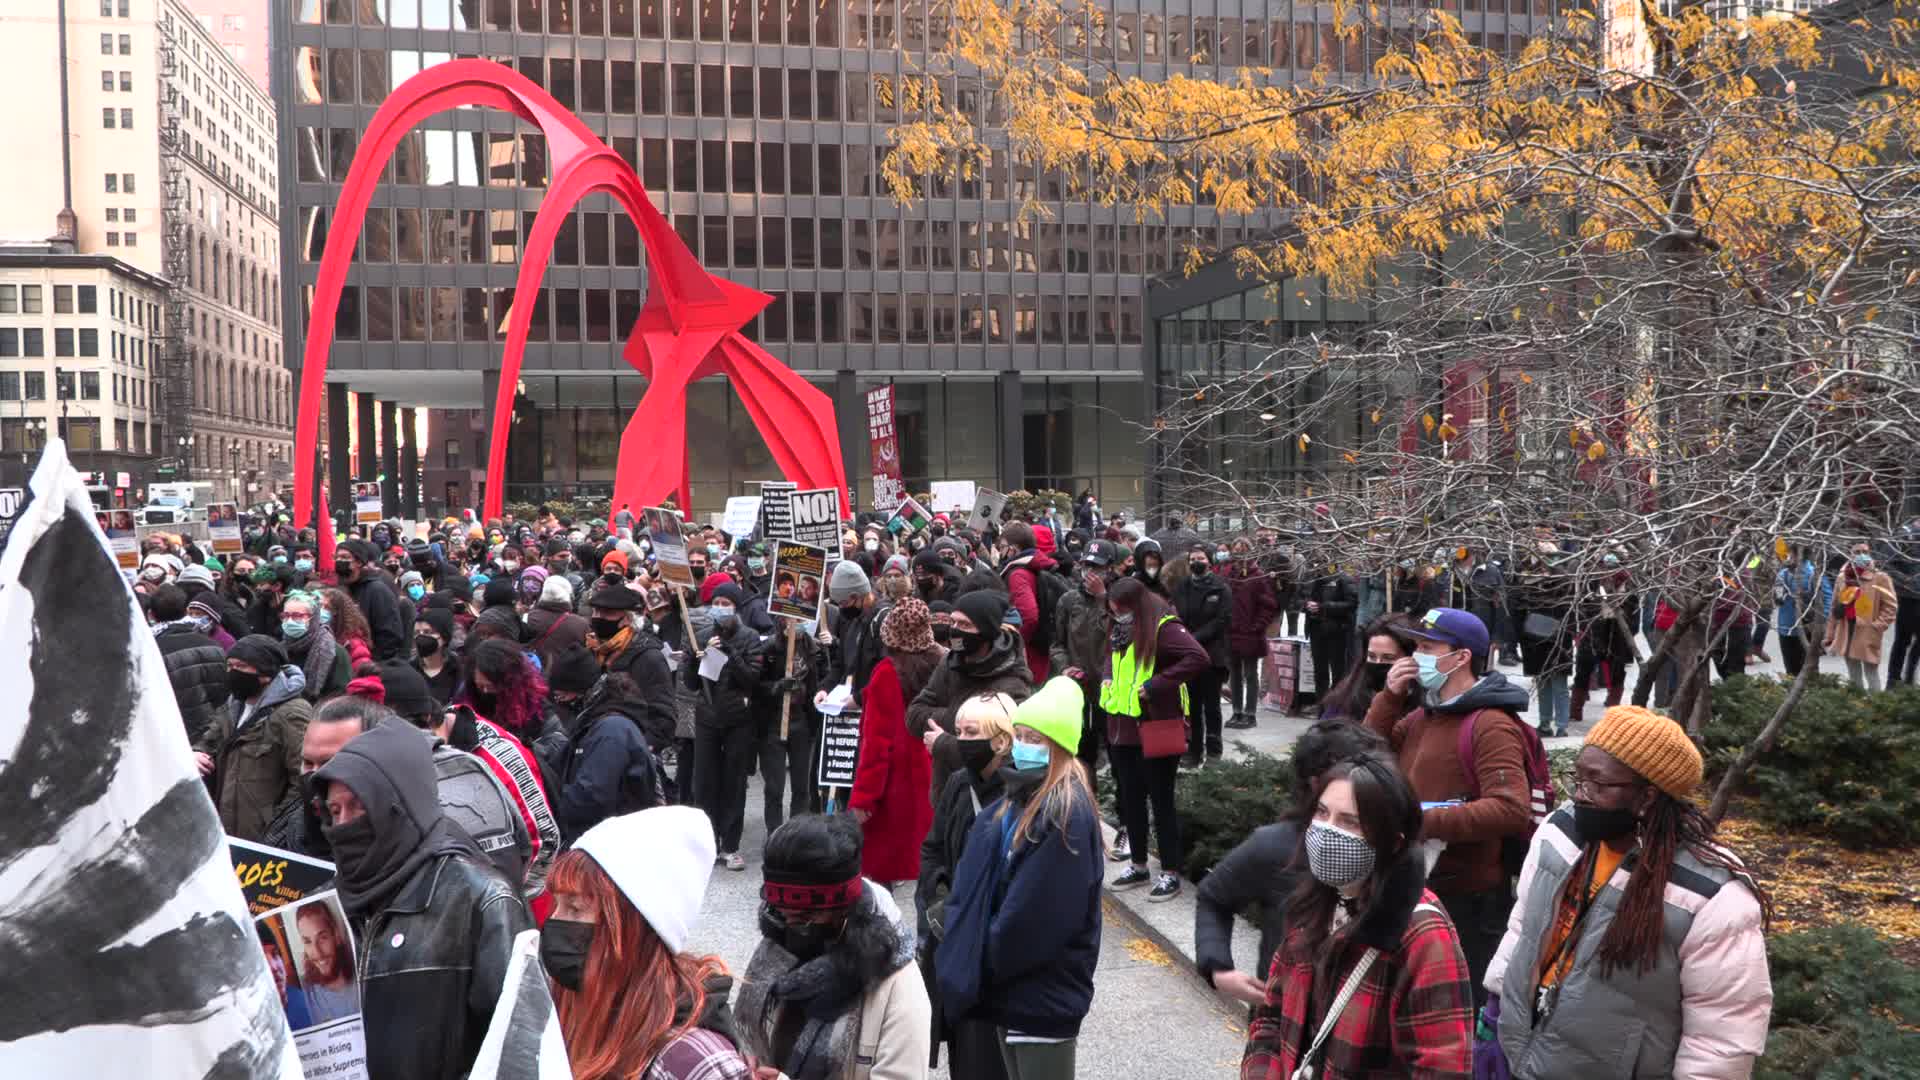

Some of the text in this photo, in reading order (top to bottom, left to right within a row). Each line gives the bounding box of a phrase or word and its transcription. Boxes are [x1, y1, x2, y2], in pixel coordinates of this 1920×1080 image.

[0, 492, 20, 518] O!
[793, 492, 836, 525] NO!
[778, 546, 808, 559] HEROES
[826, 737, 858, 747] We REFUSE
[834, 748, 855, 759] Accept
[235, 860, 288, 889] ROES
[275, 886, 300, 900] killed
[320, 1047, 328, 1057] in
[328, 1042, 352, 1056] Rising
